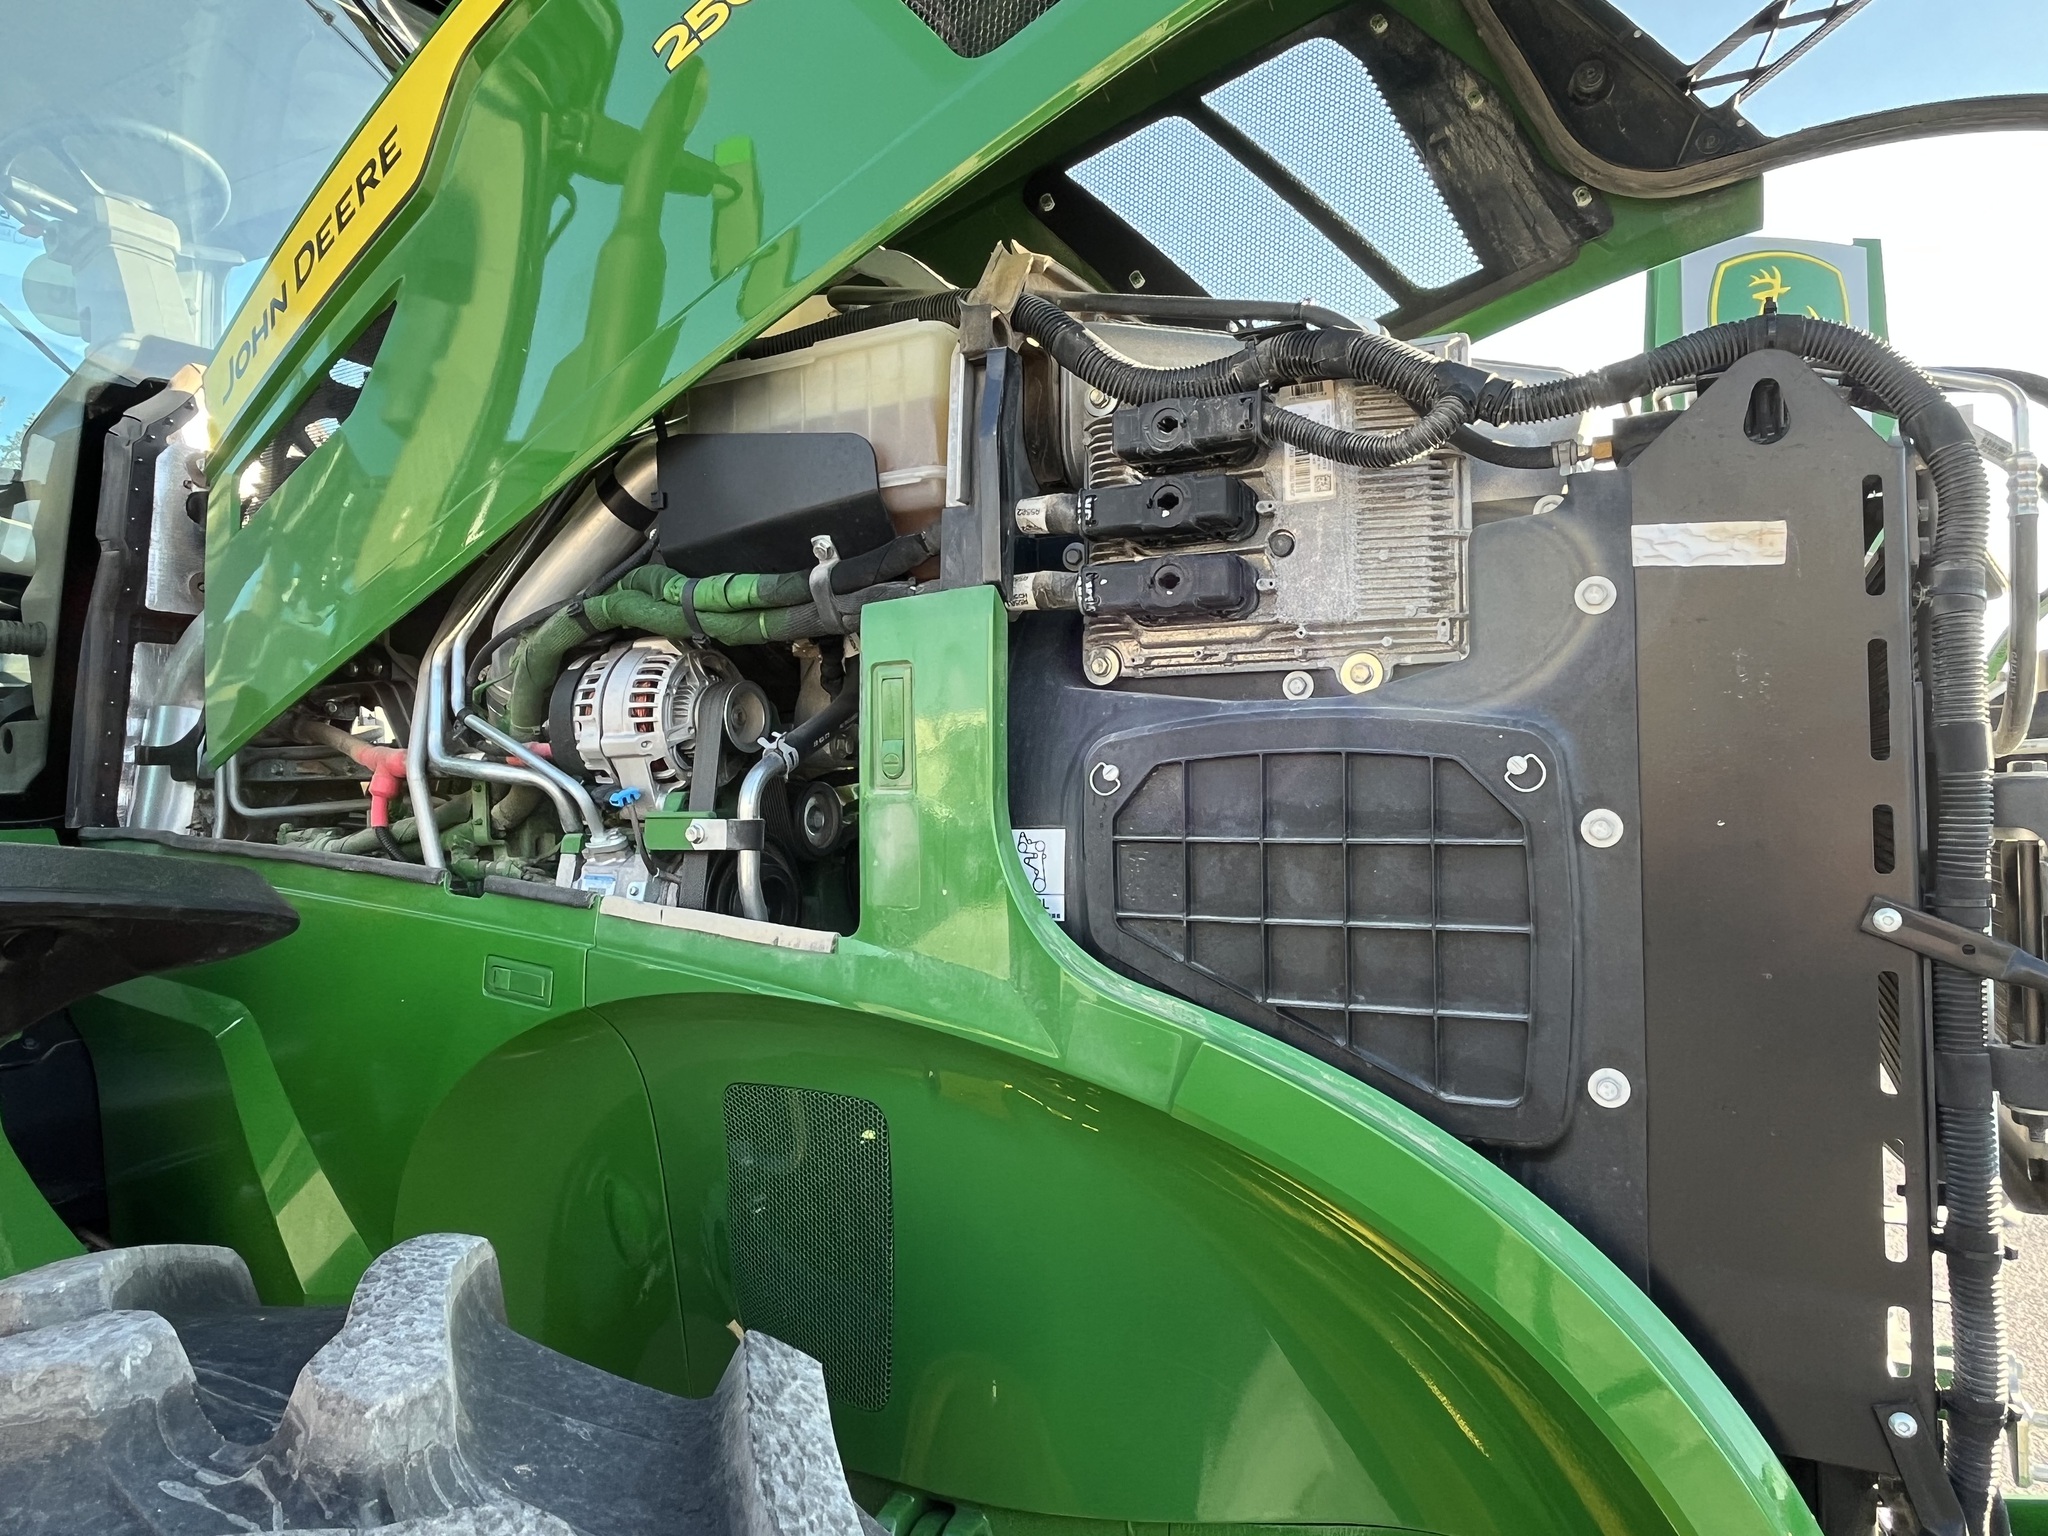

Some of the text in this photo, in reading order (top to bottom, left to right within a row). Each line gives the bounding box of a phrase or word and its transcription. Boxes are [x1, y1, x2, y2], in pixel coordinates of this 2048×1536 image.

[652, 0, 752, 74] 25
[222, 124, 402, 405] JOHN DEERE
